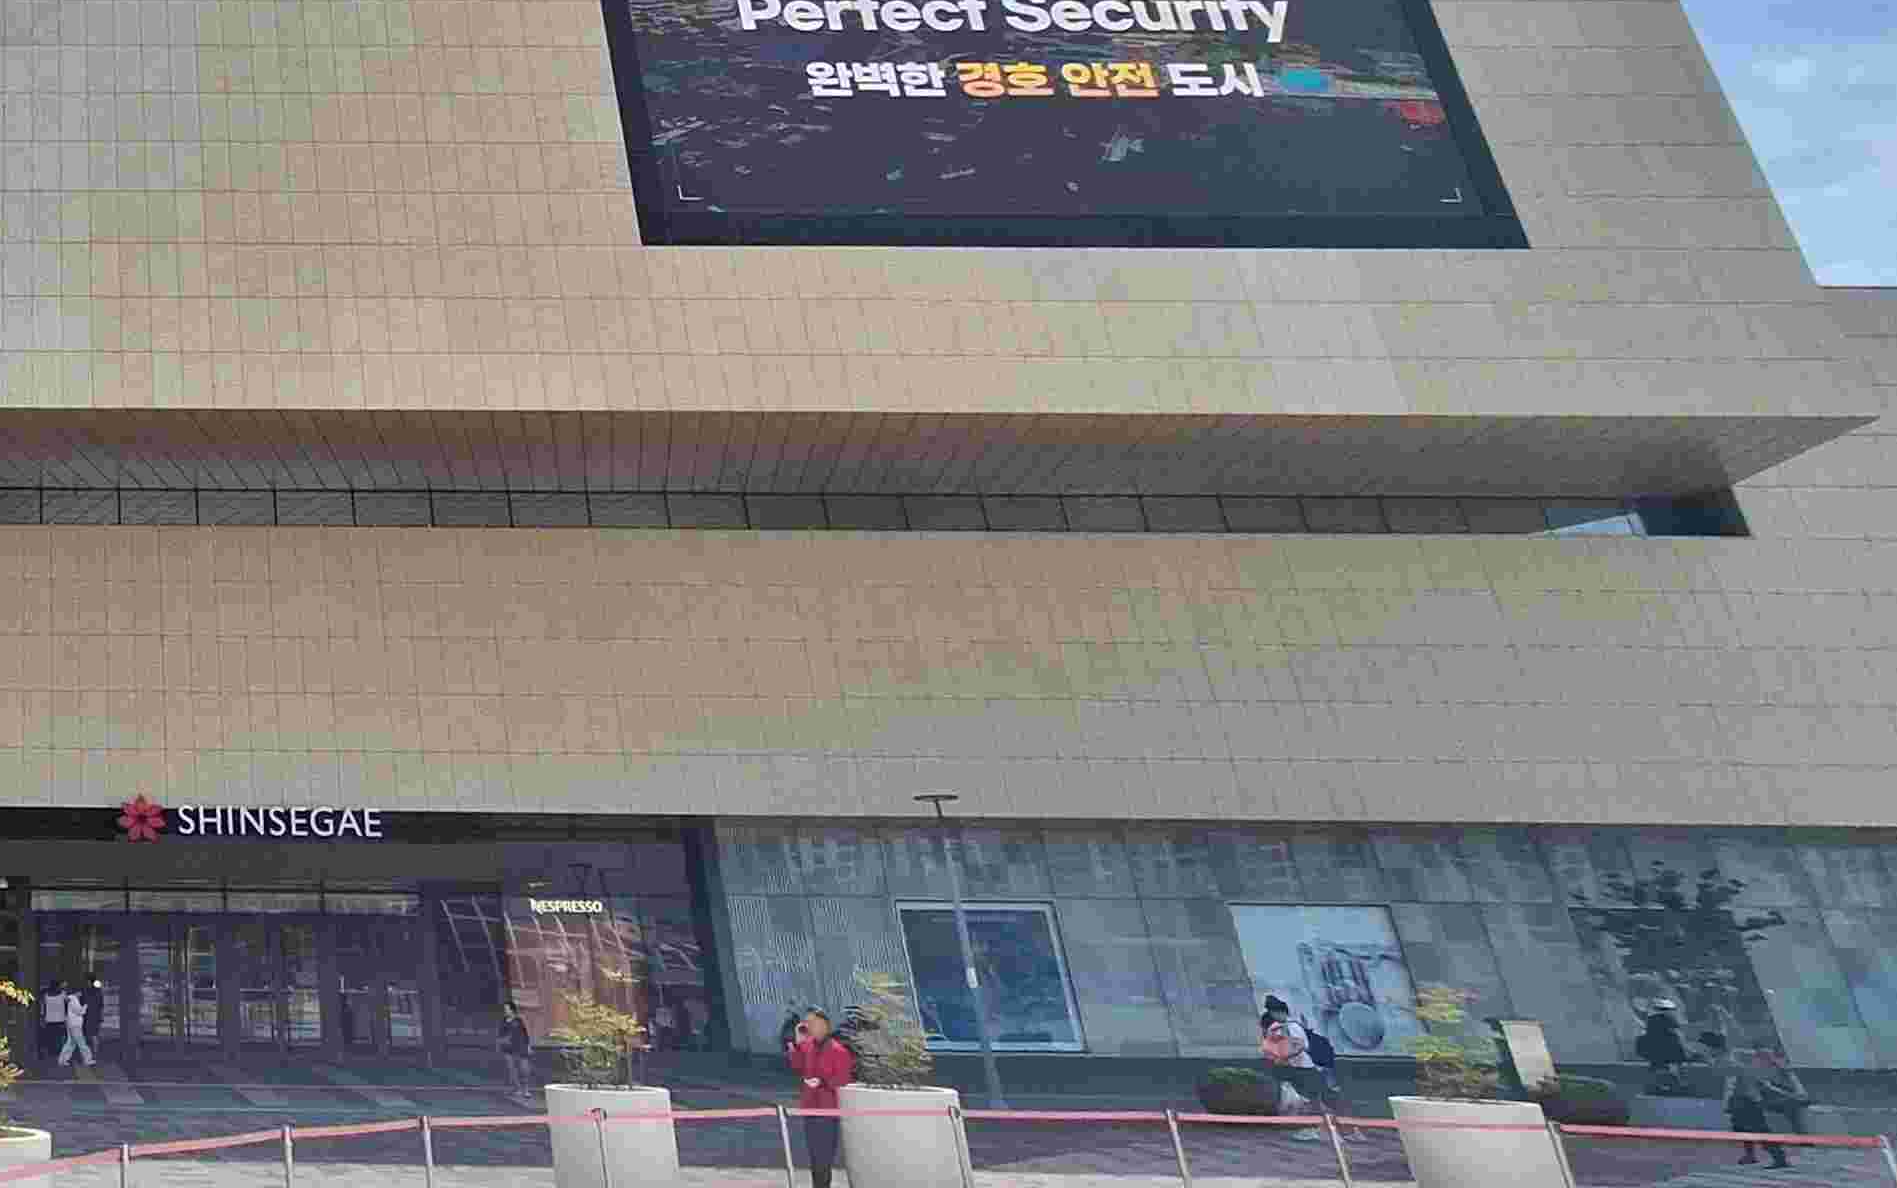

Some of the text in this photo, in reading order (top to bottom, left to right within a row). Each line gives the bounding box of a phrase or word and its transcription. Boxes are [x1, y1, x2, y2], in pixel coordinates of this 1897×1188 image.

[806, 60, 1265, 98] 완벽한 경호 안전 도시
[178, 805, 384, 838] SHINSEGAE
[530, 898, 602, 914] NESPRESSO
